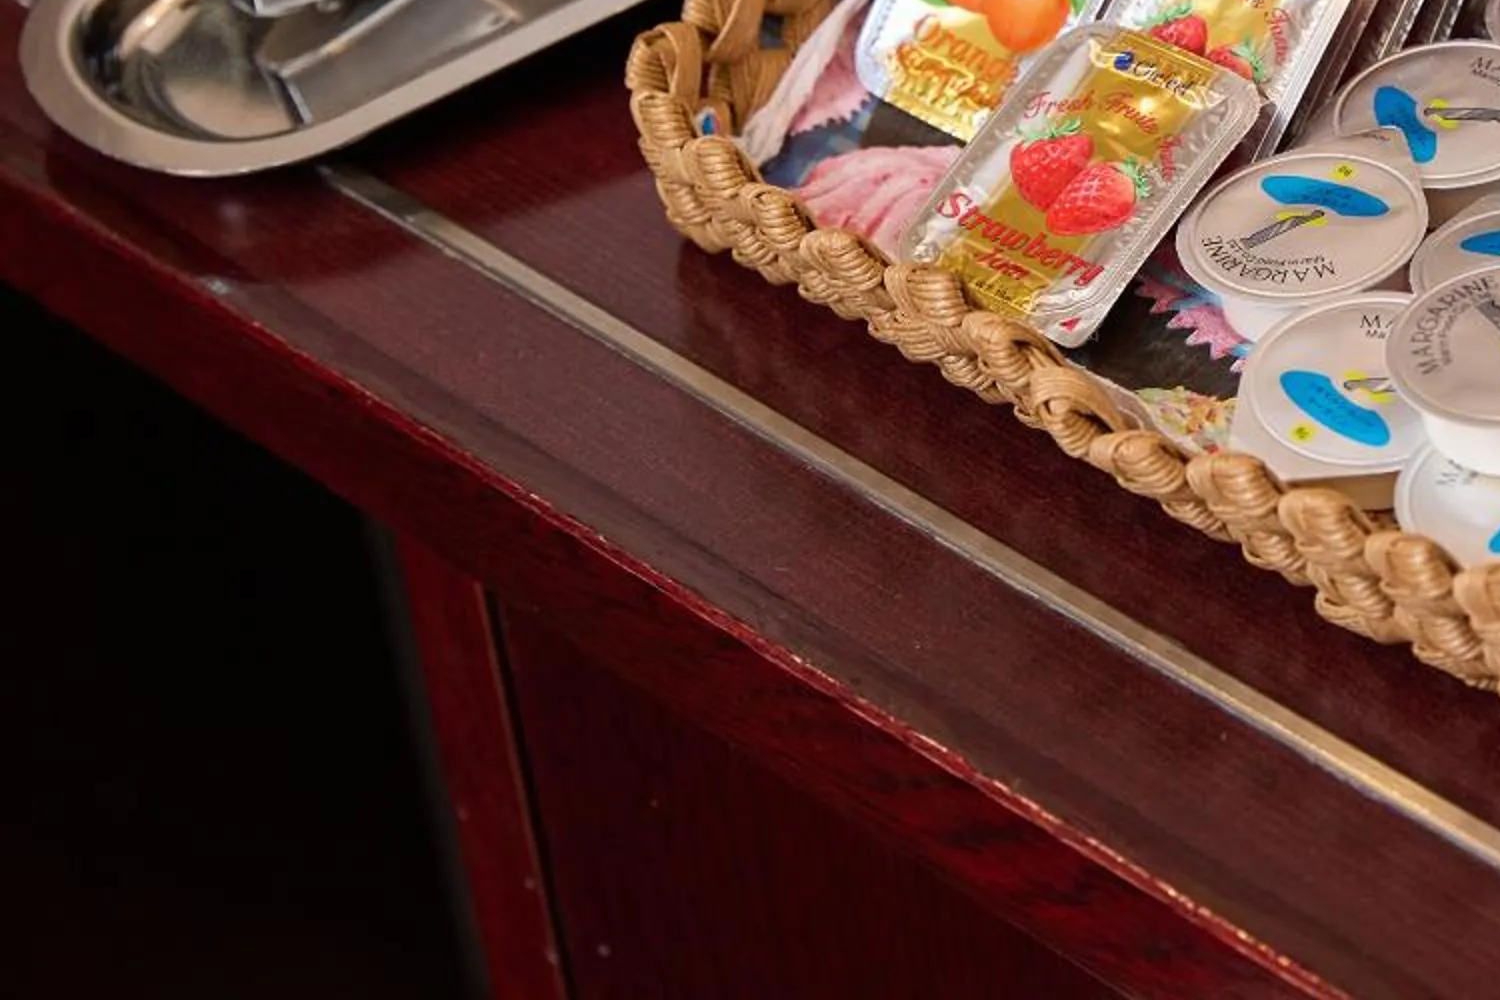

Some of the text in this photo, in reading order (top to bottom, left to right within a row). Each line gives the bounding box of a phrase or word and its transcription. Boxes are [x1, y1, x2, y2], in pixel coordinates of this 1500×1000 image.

[936, 192, 1104, 287] Strawberry
[1201, 235, 1336, 284] MARGARINE
[1410, 276, 1498, 376] MARGARINE
